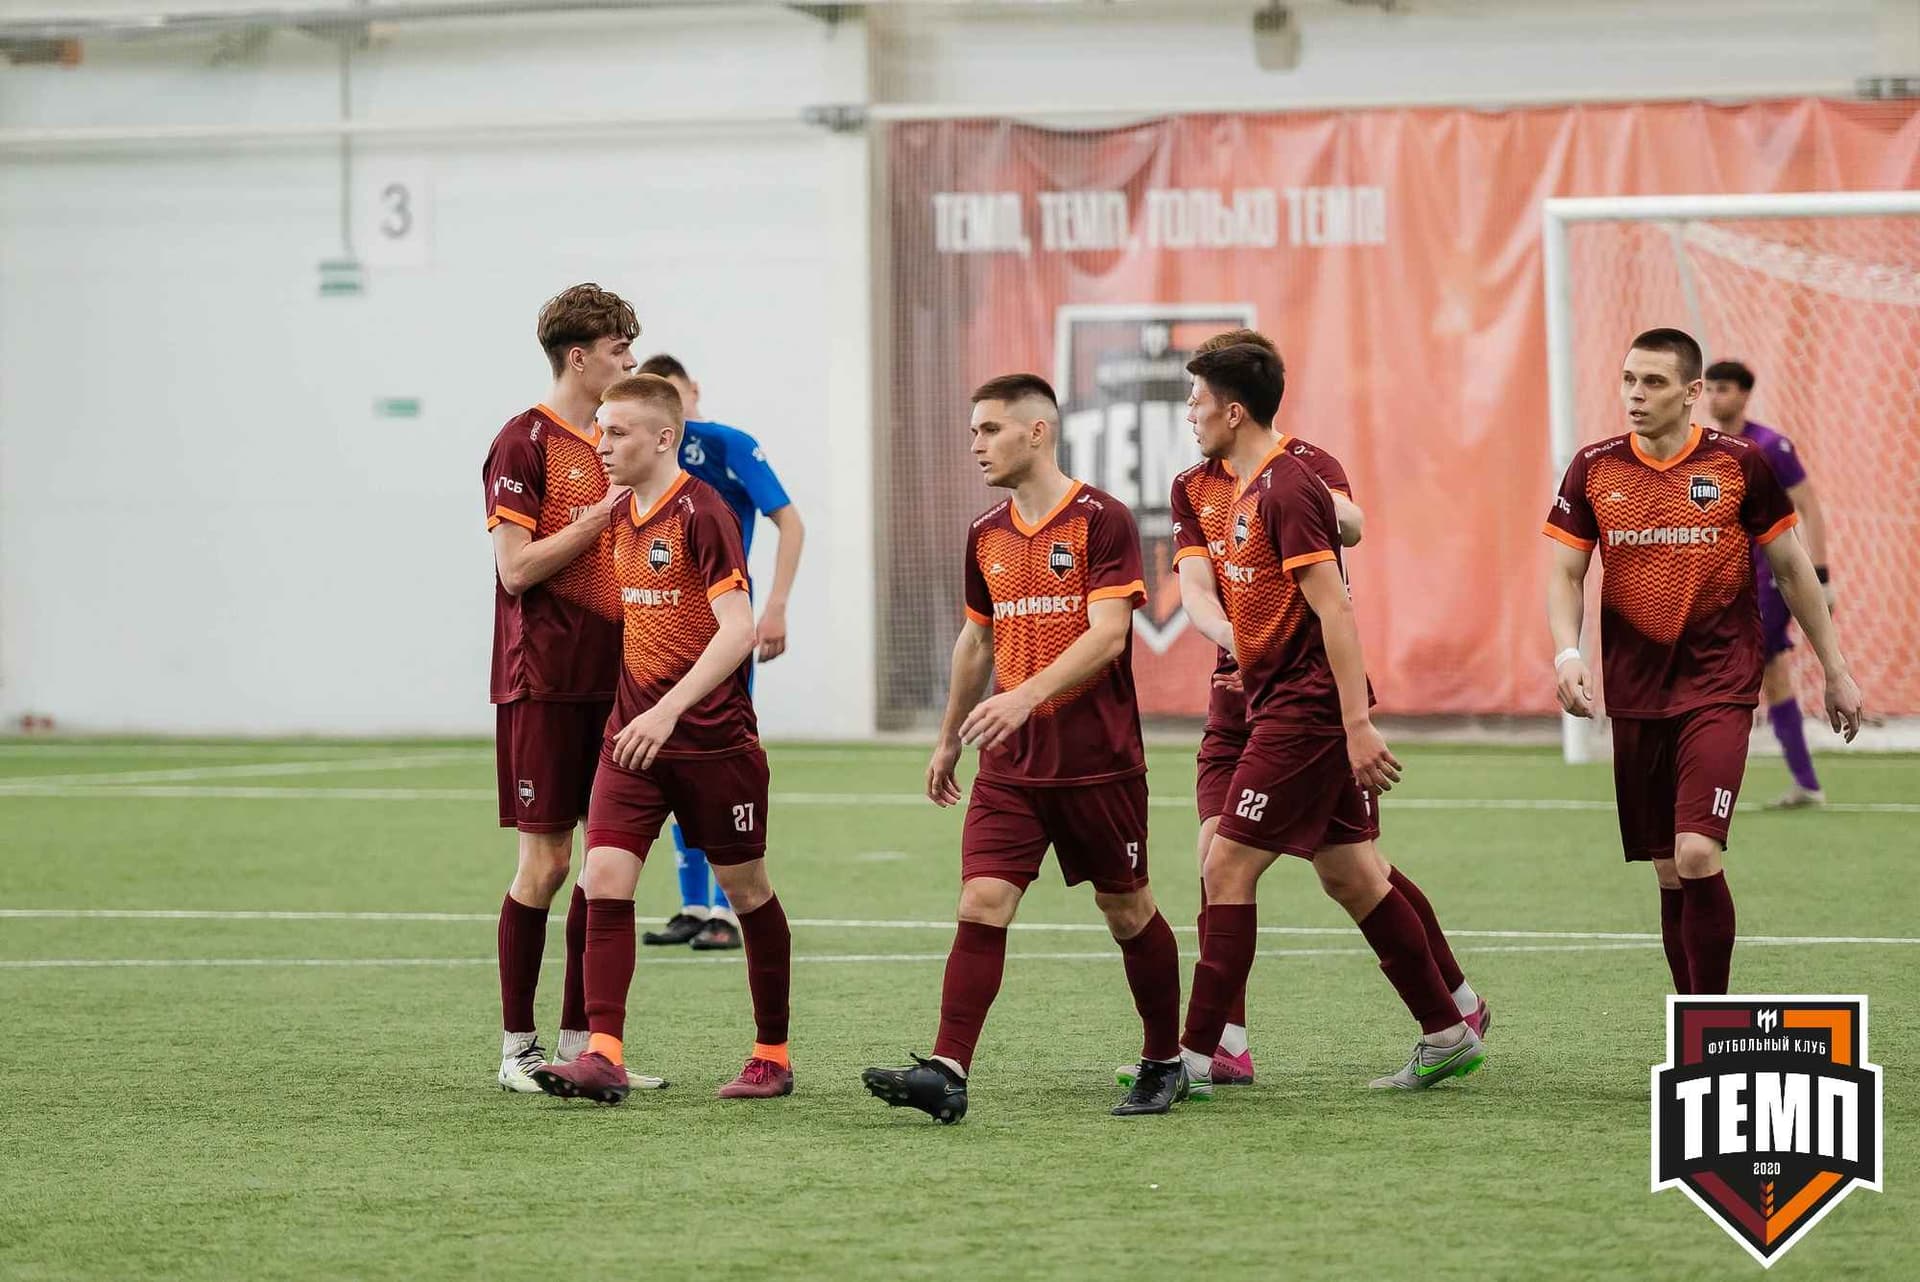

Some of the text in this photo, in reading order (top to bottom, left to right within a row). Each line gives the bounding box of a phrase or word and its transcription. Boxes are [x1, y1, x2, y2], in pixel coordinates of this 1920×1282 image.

[380, 183, 413, 239] 3
[1064, 400, 1200, 510] ТЕМ
[1692, 485, 1718, 499] ТЕМП
[732, 802, 754, 832] 27
[1235, 788, 1269, 822] 22
[1712, 787, 1732, 819] 19
